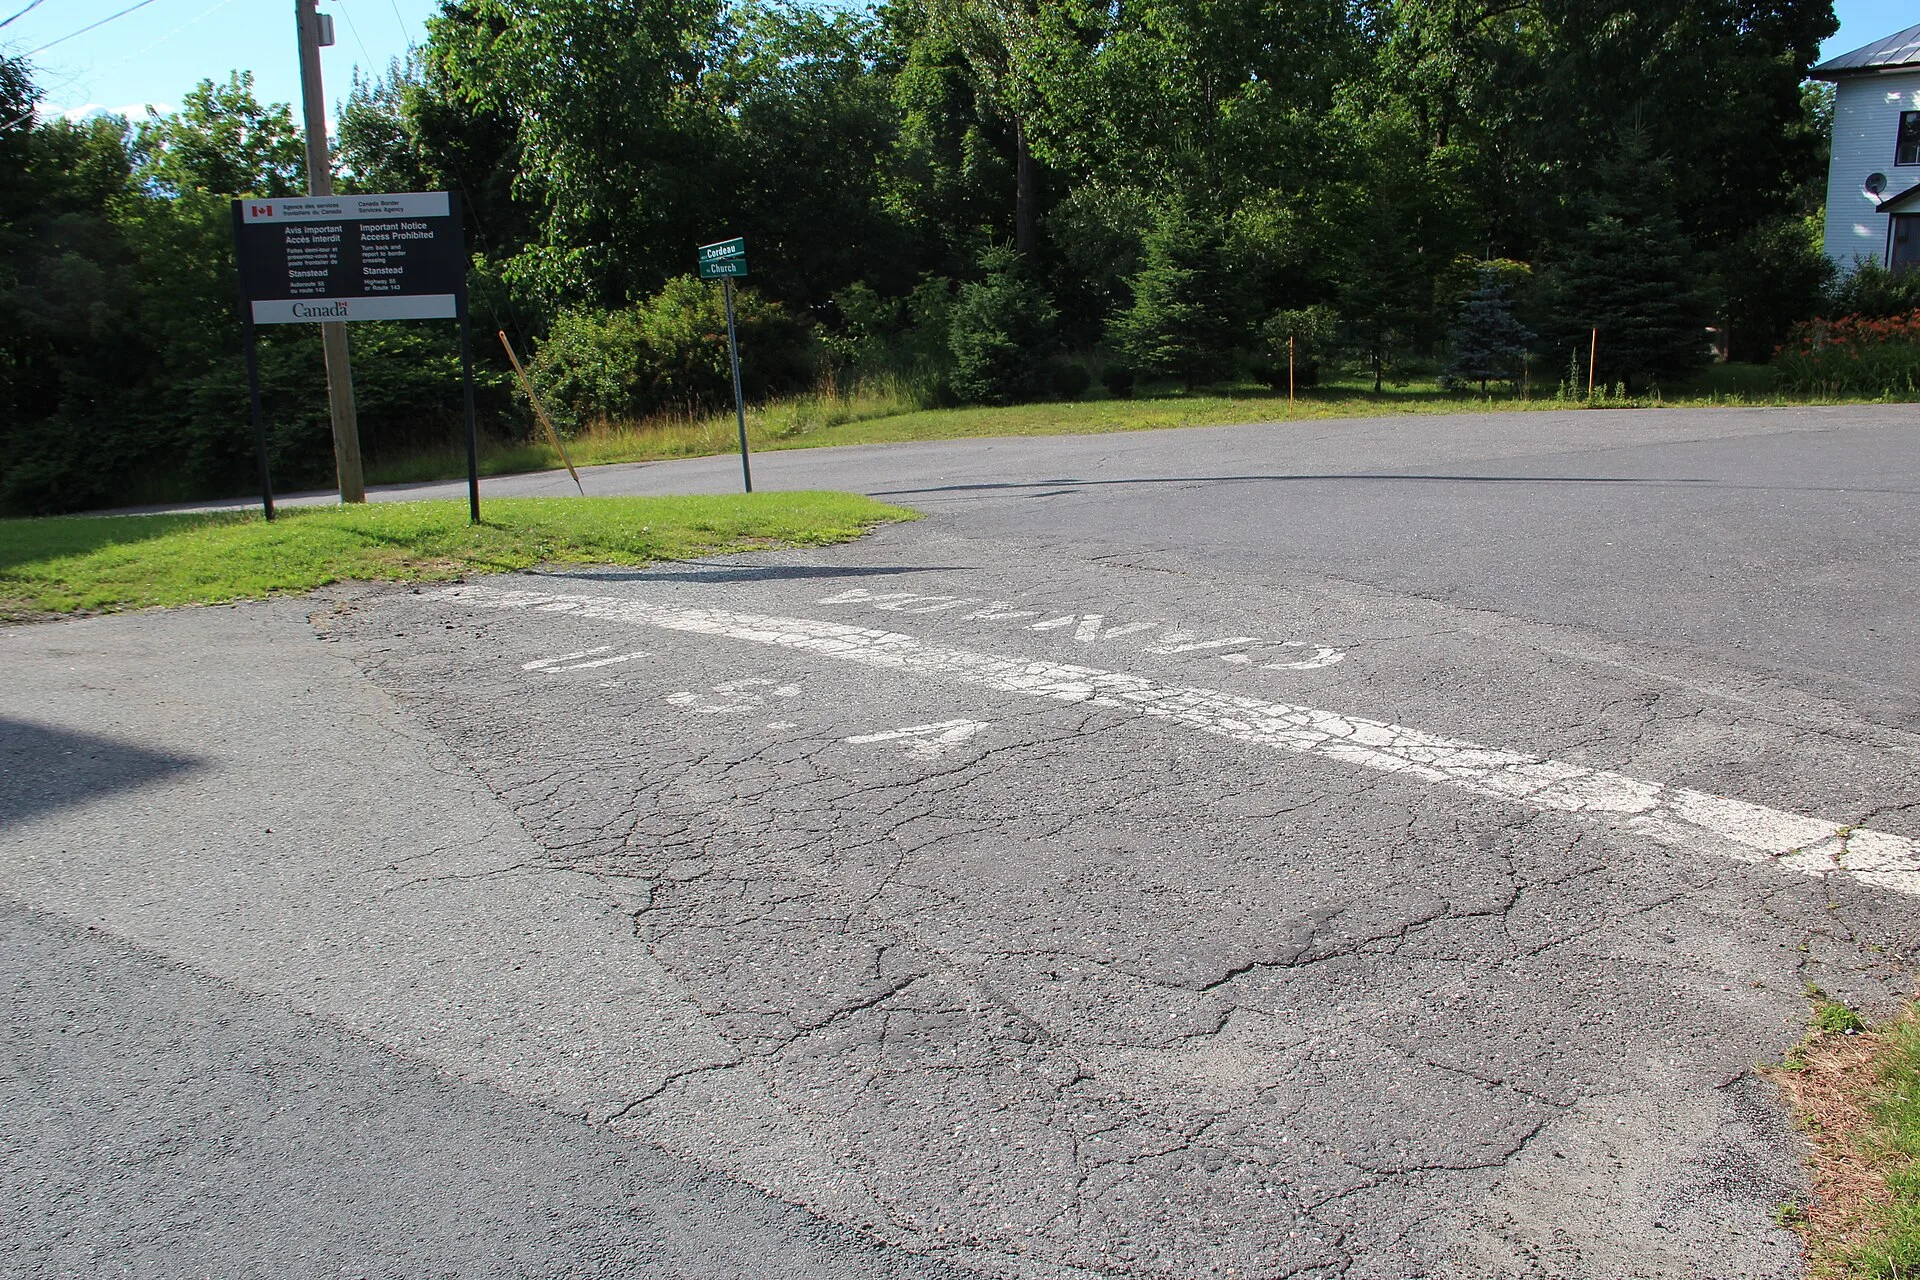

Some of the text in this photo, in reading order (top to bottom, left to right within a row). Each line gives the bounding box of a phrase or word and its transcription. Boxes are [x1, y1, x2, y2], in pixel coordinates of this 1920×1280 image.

[285, 225, 343, 234] Avis important
[360, 221, 427, 232] Important Notice
[392, 231, 434, 240] Prohibited
[707, 245, 736, 259] Cordeau
[363, 266, 404, 275] Stanstead
[711, 263, 737, 273] Church
[289, 269, 329, 278] Stanstead
[292, 301, 348, 318] Canada
